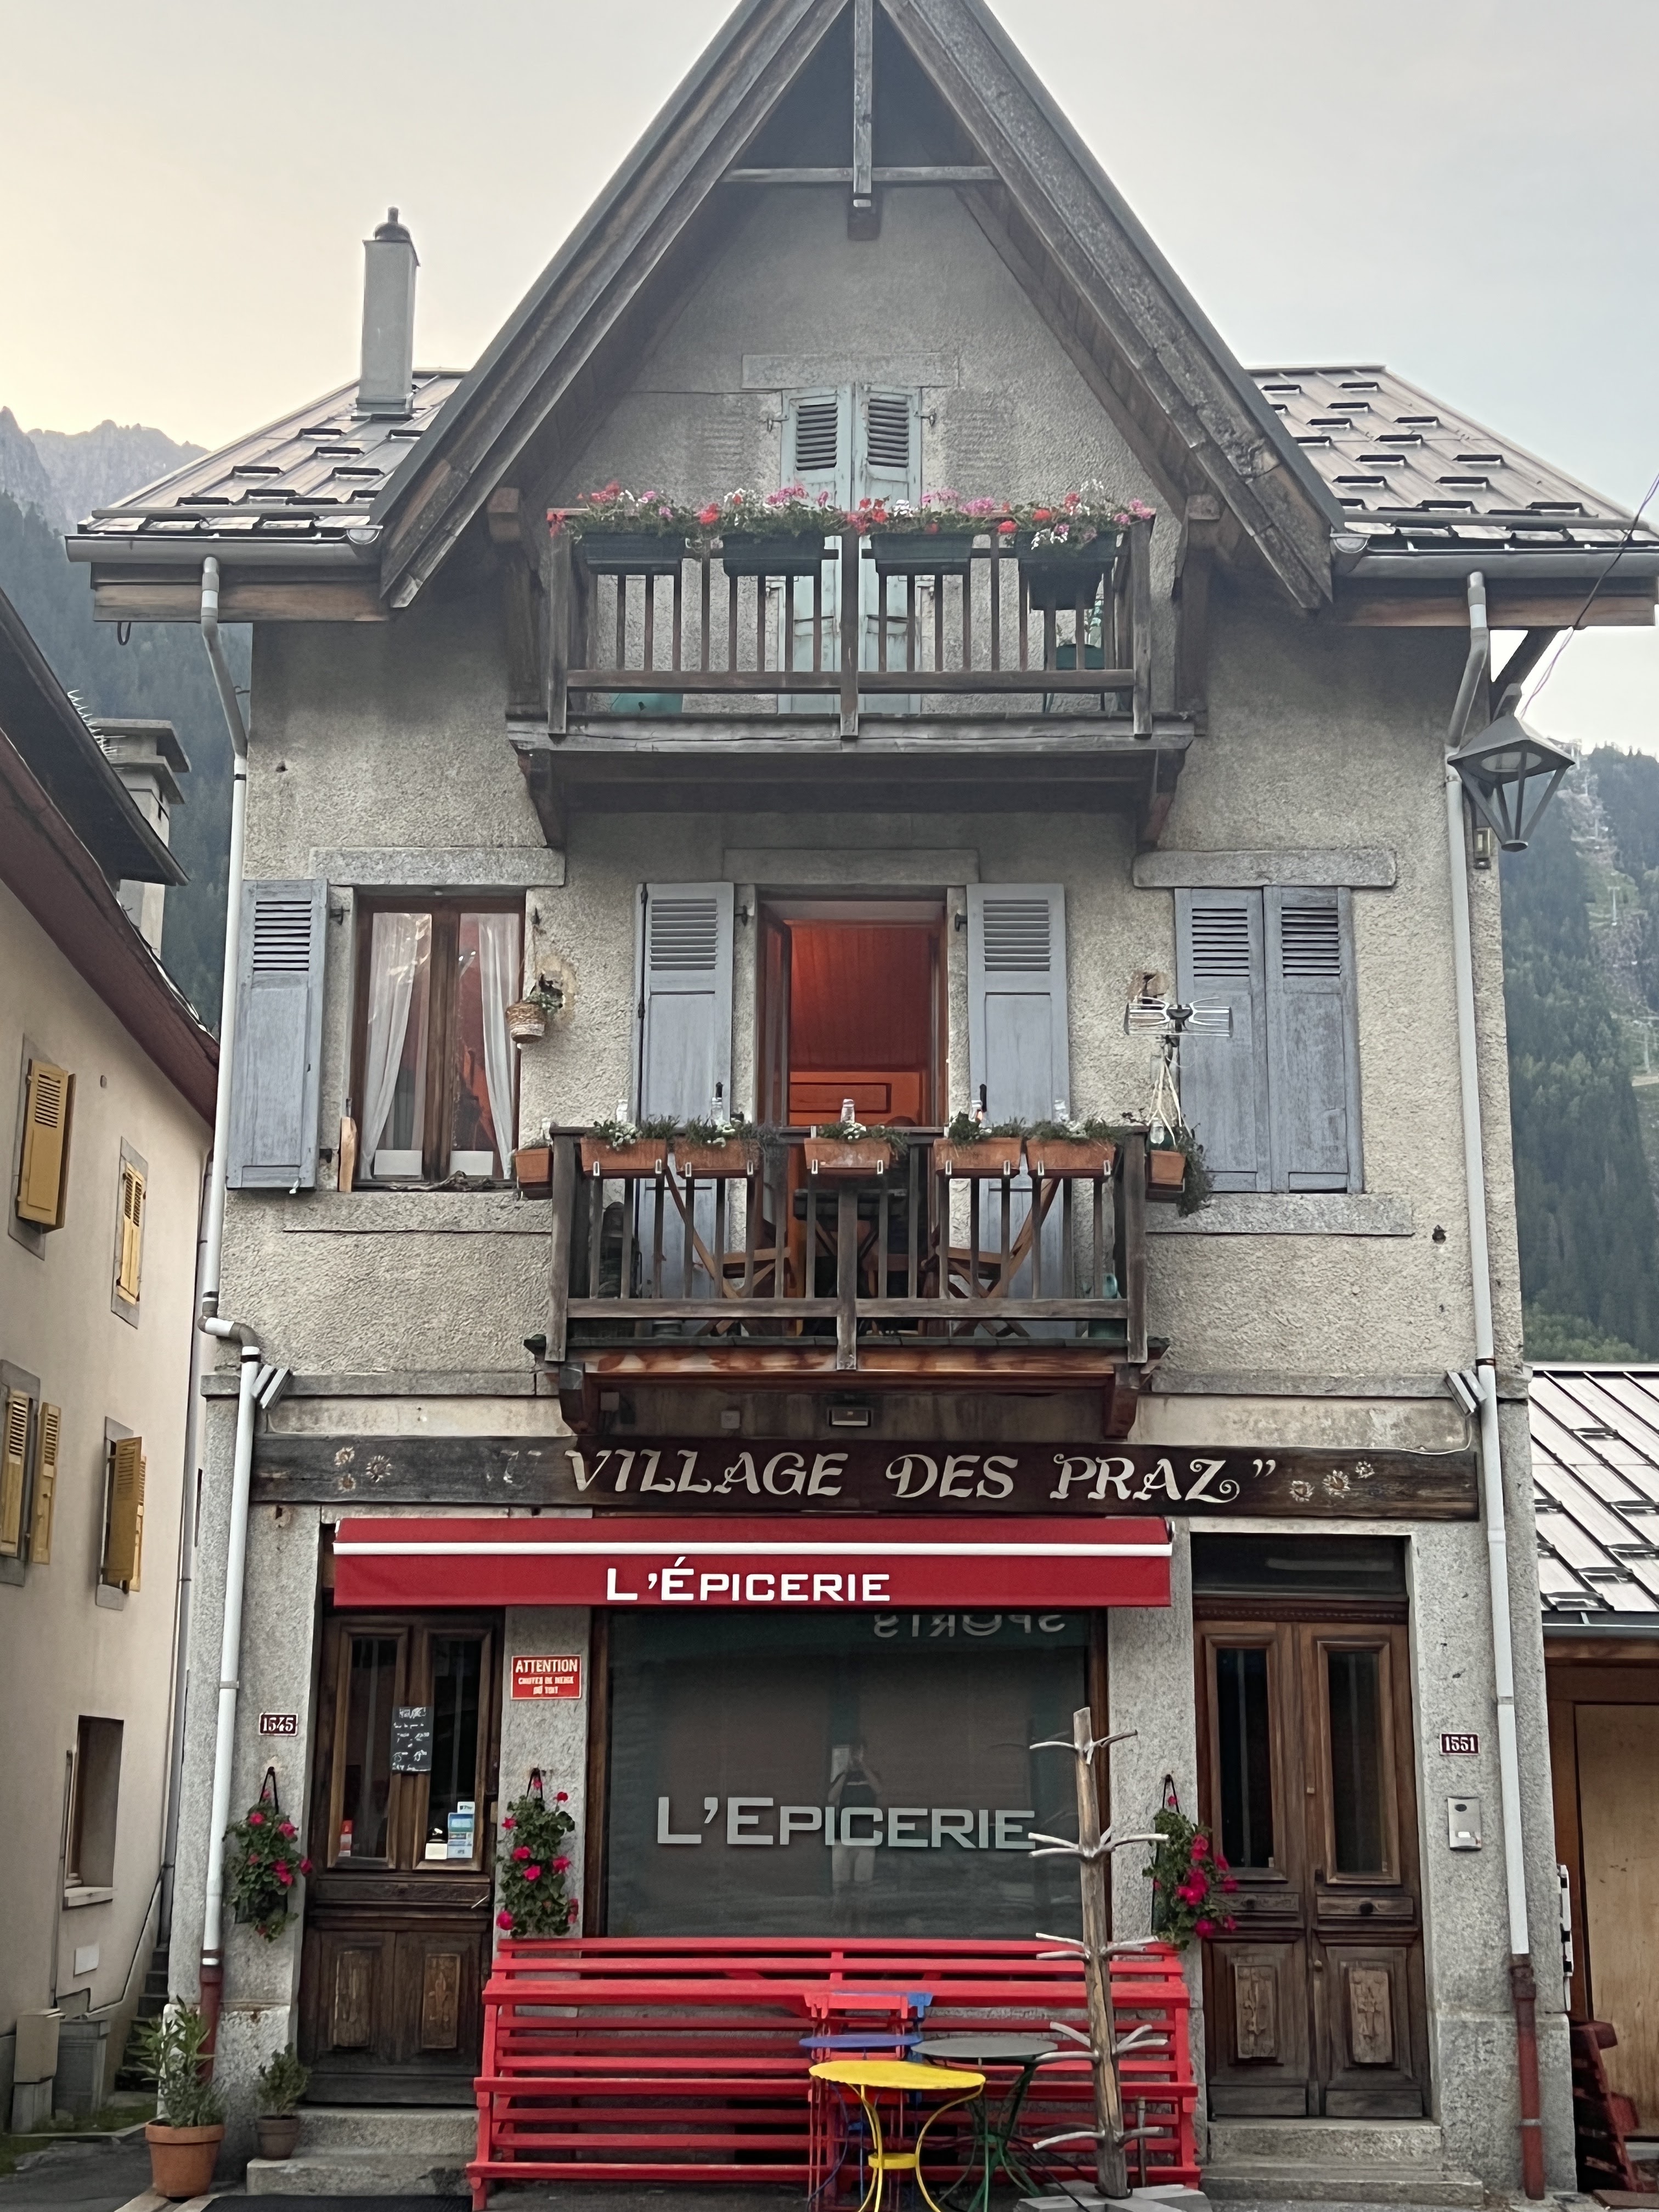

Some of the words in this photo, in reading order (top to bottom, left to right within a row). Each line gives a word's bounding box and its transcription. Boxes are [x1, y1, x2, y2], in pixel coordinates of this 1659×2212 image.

[564, 1449, 849, 1496] VILLAGE
[885, 1454, 1019, 1499] DES
[606, 1556, 890, 1601] L'ÉPICERIE
[515, 1658, 578, 1673] ATTENTION
[263, 1717, 294, 1732] 1545
[1445, 1736, 1476, 1752] 1551
[657, 1796, 1036, 1849] L'EPICERIE
